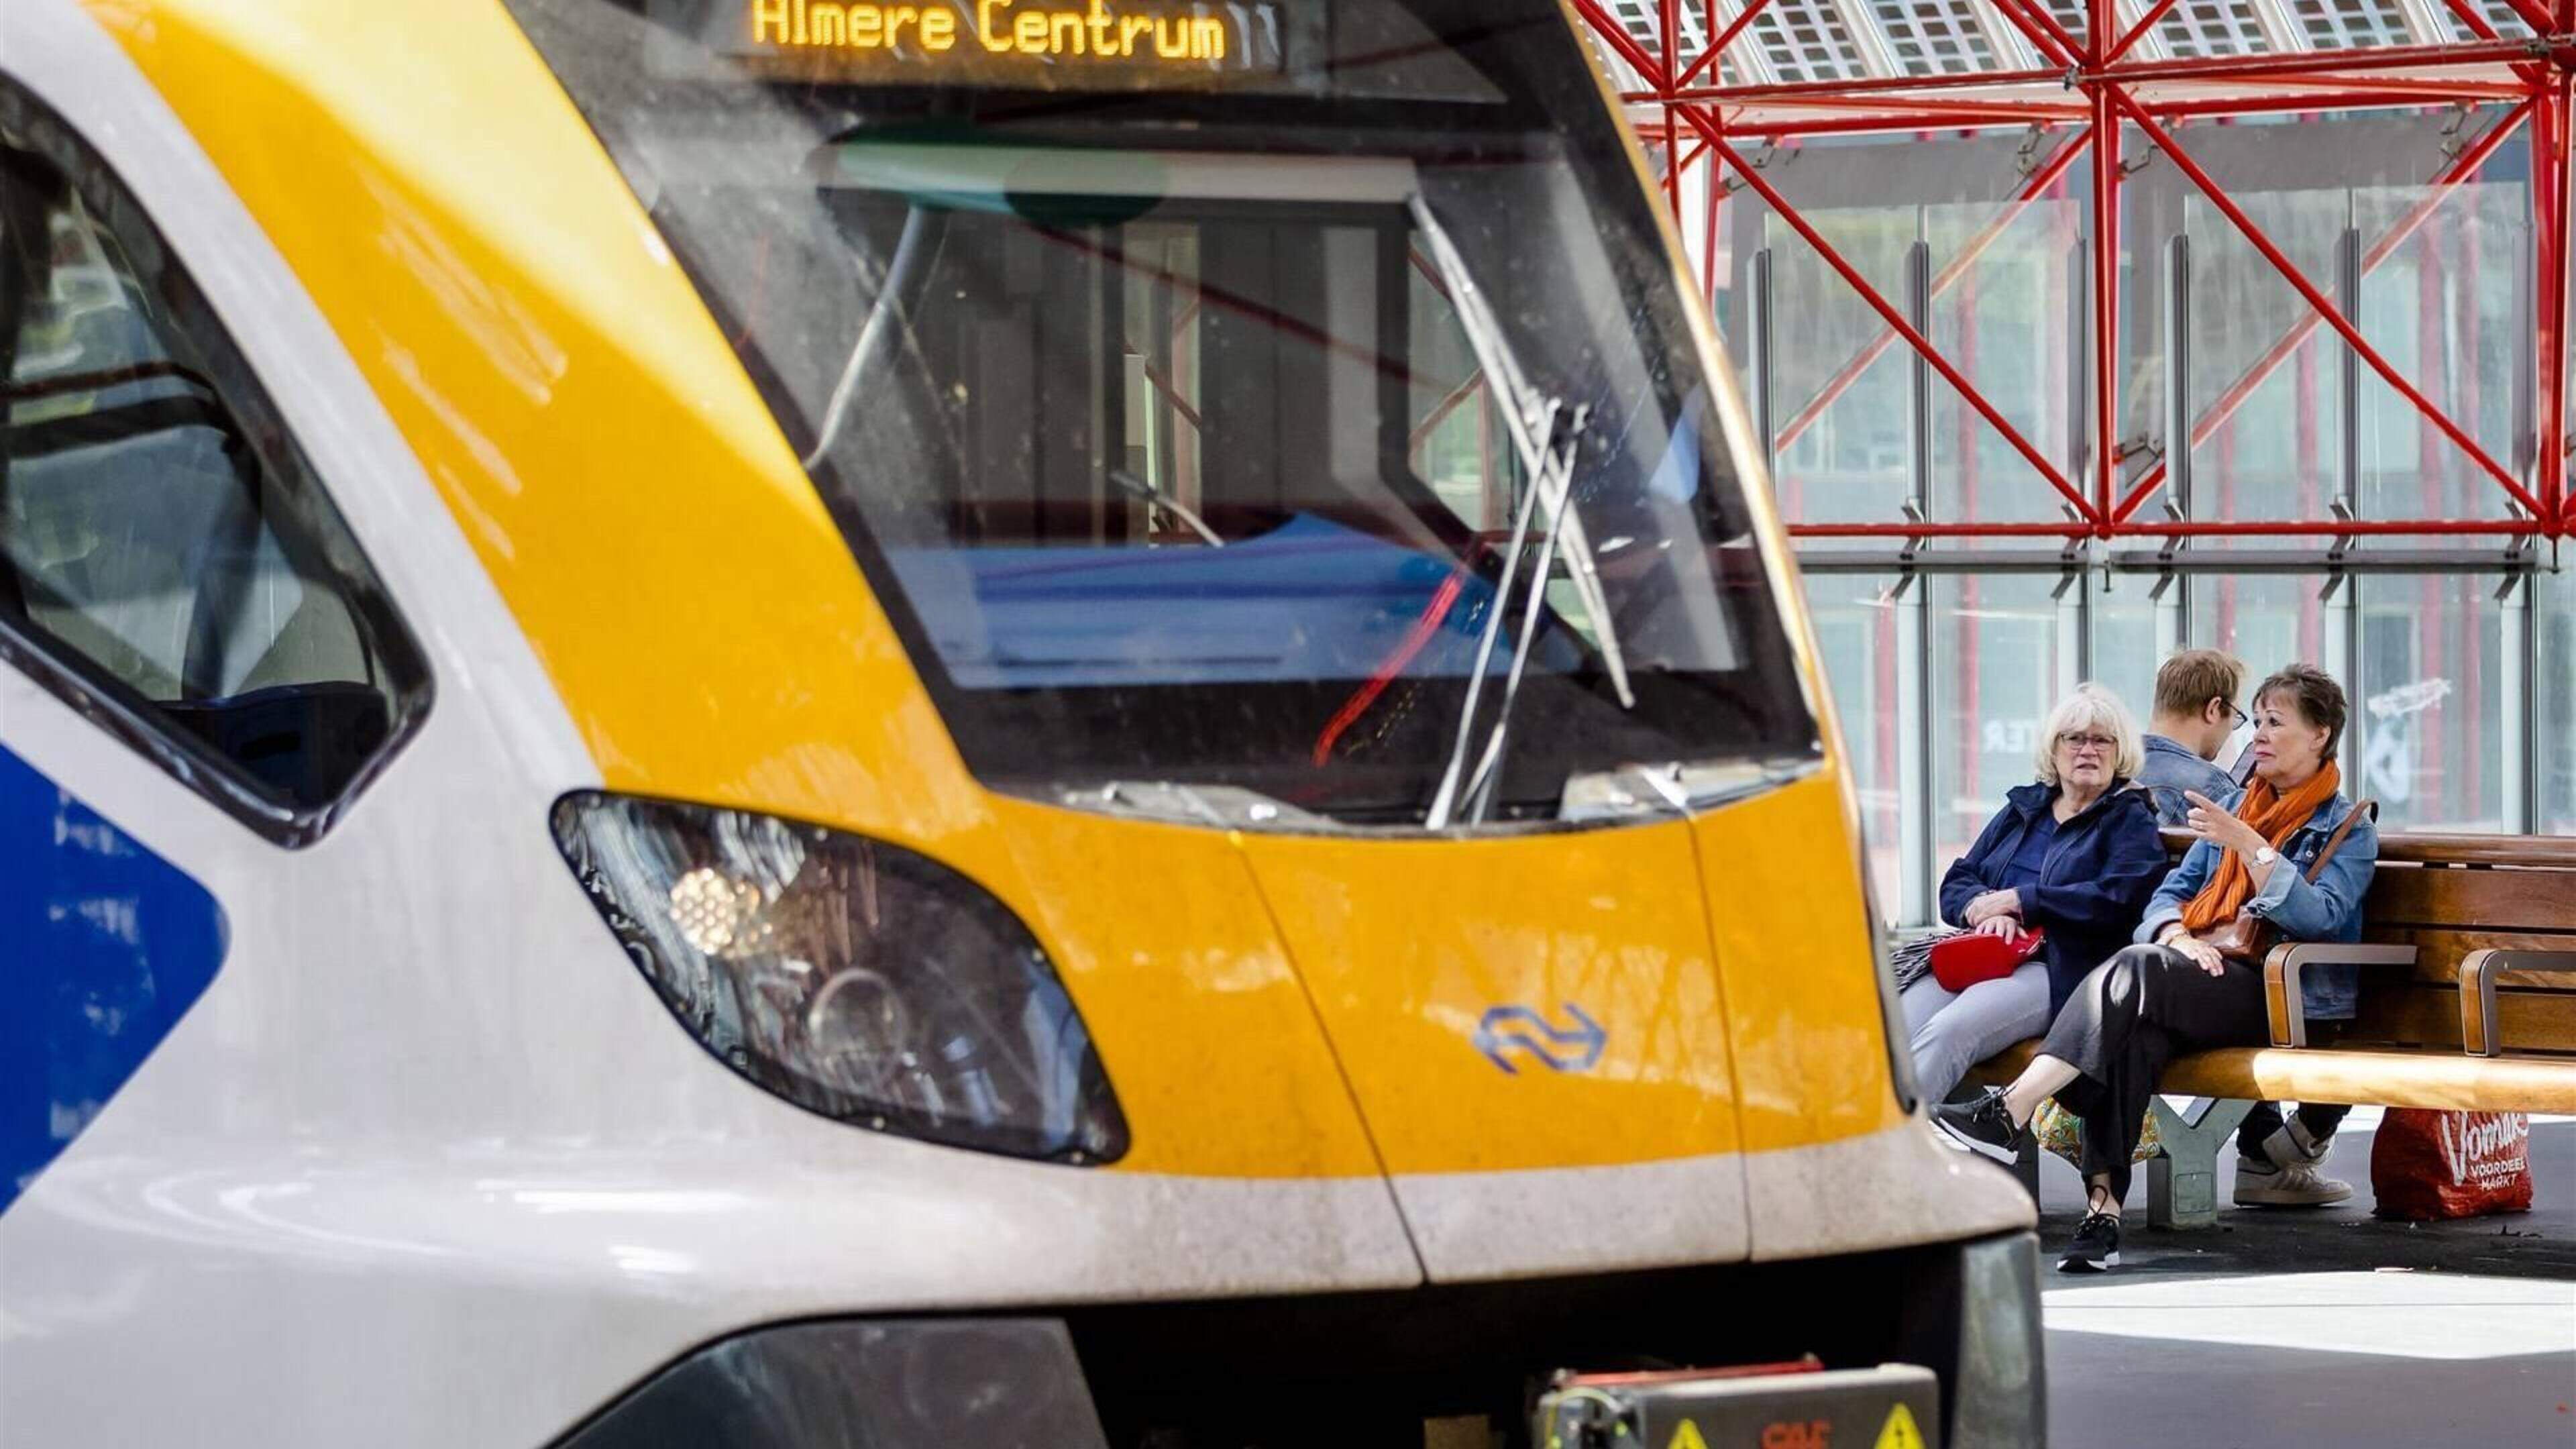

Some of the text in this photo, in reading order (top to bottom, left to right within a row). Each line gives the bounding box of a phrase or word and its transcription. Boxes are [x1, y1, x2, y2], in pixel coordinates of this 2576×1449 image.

[752, 0, 1226, 59] Almere Centrum
[2470, 1157, 2526, 1178] VOORDEEL
[2480, 1173, 2517, 1191] MARKT
